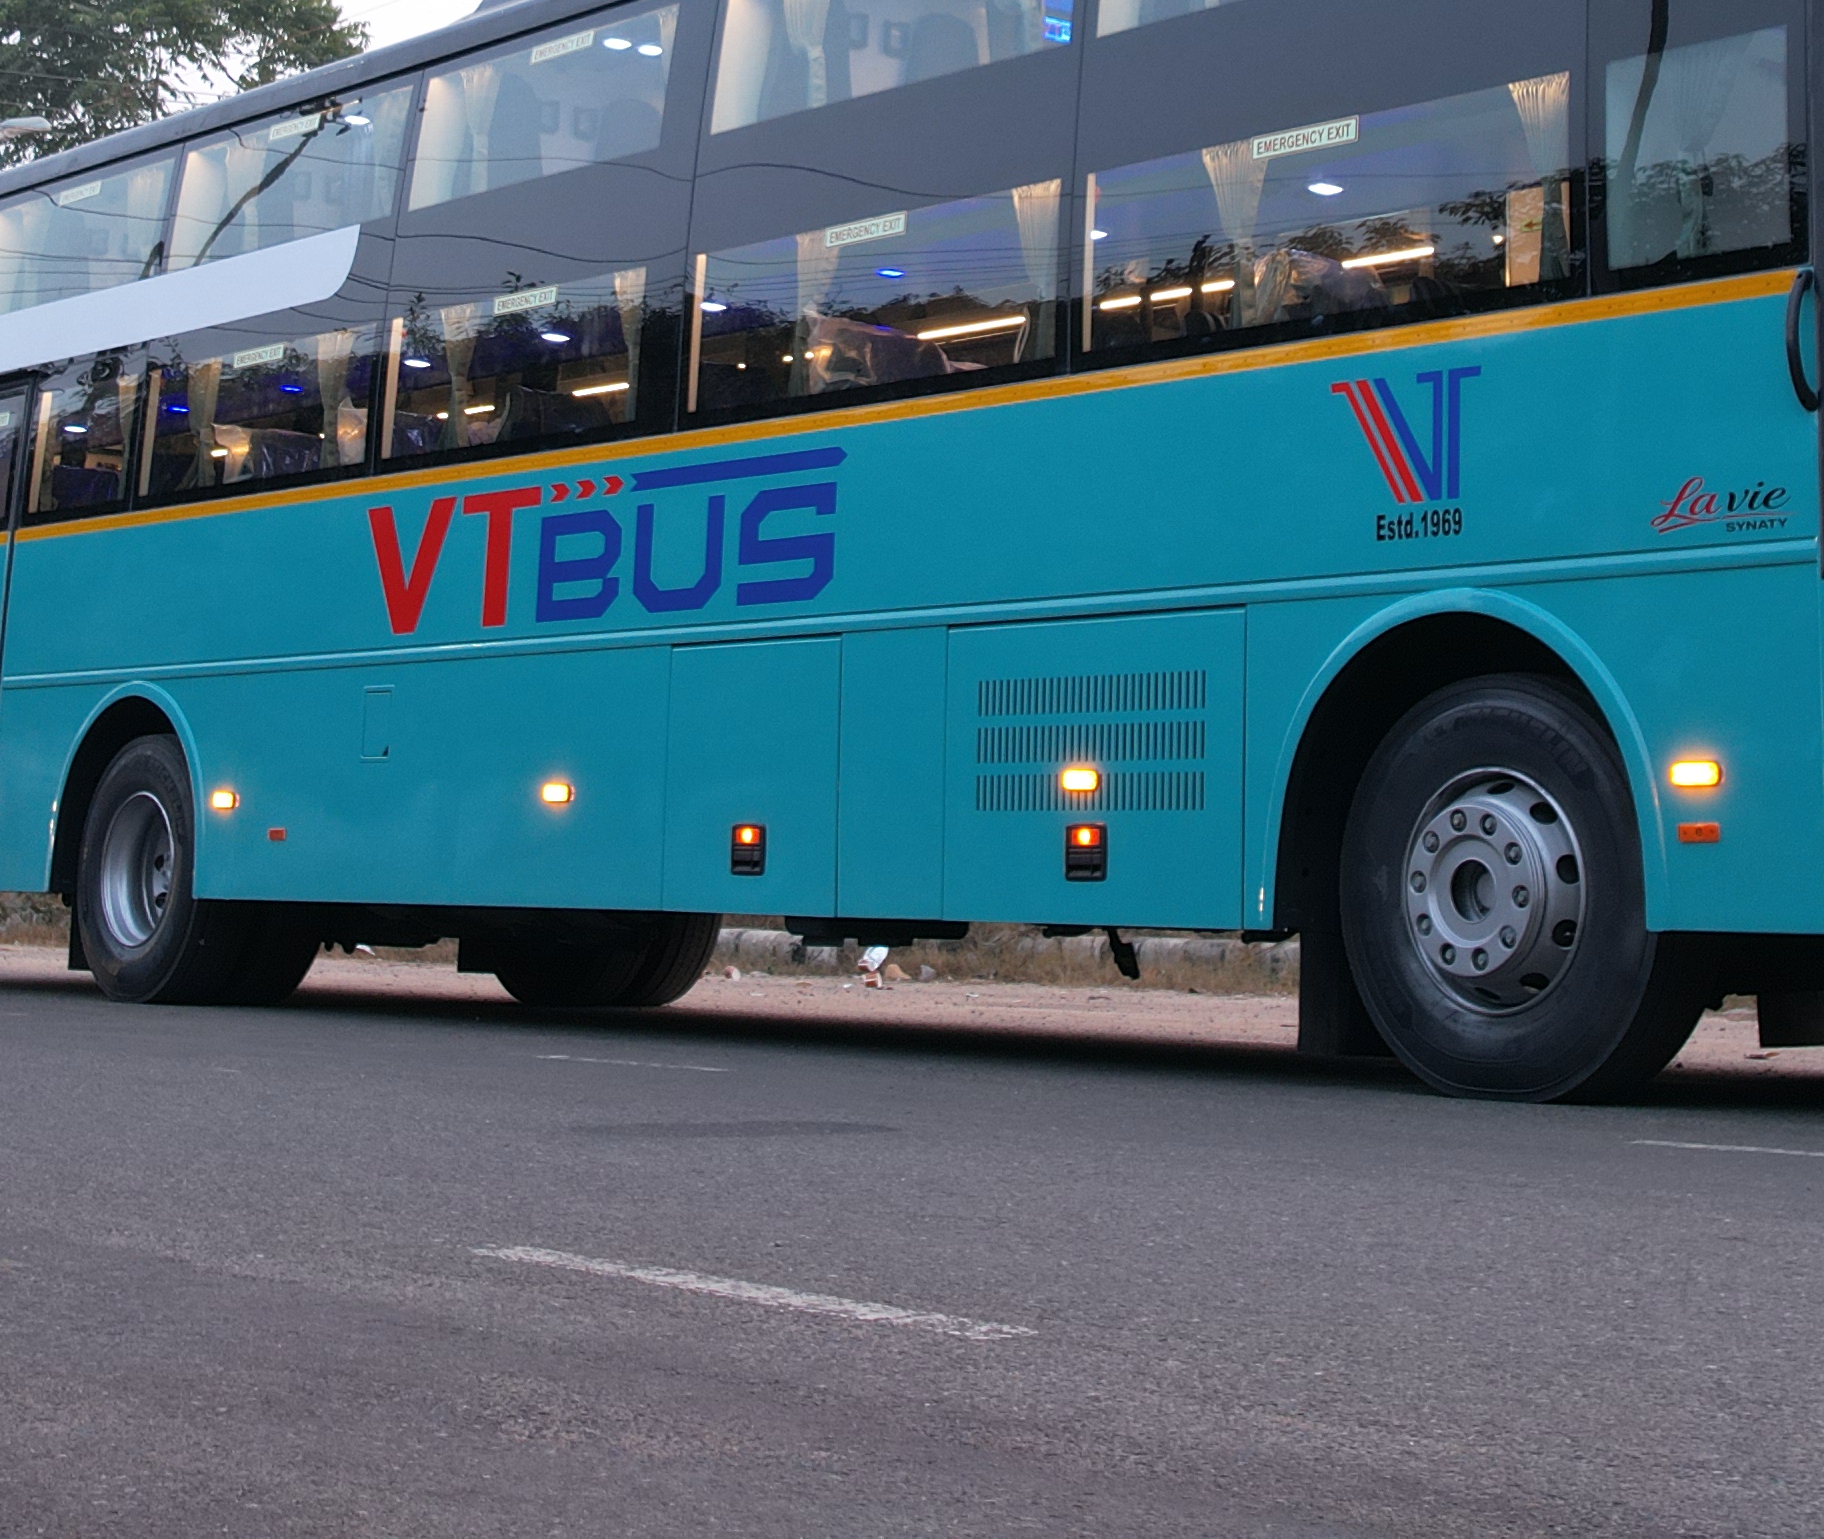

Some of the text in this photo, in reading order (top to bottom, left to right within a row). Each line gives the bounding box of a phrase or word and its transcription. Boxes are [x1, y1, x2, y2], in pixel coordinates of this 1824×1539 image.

[1256, 122, 1352, 155] EMERGENCY EXIT
[829, 216, 902, 244] EMERGENCY EXIT
[1725, 518, 1788, 533] SYNATY
